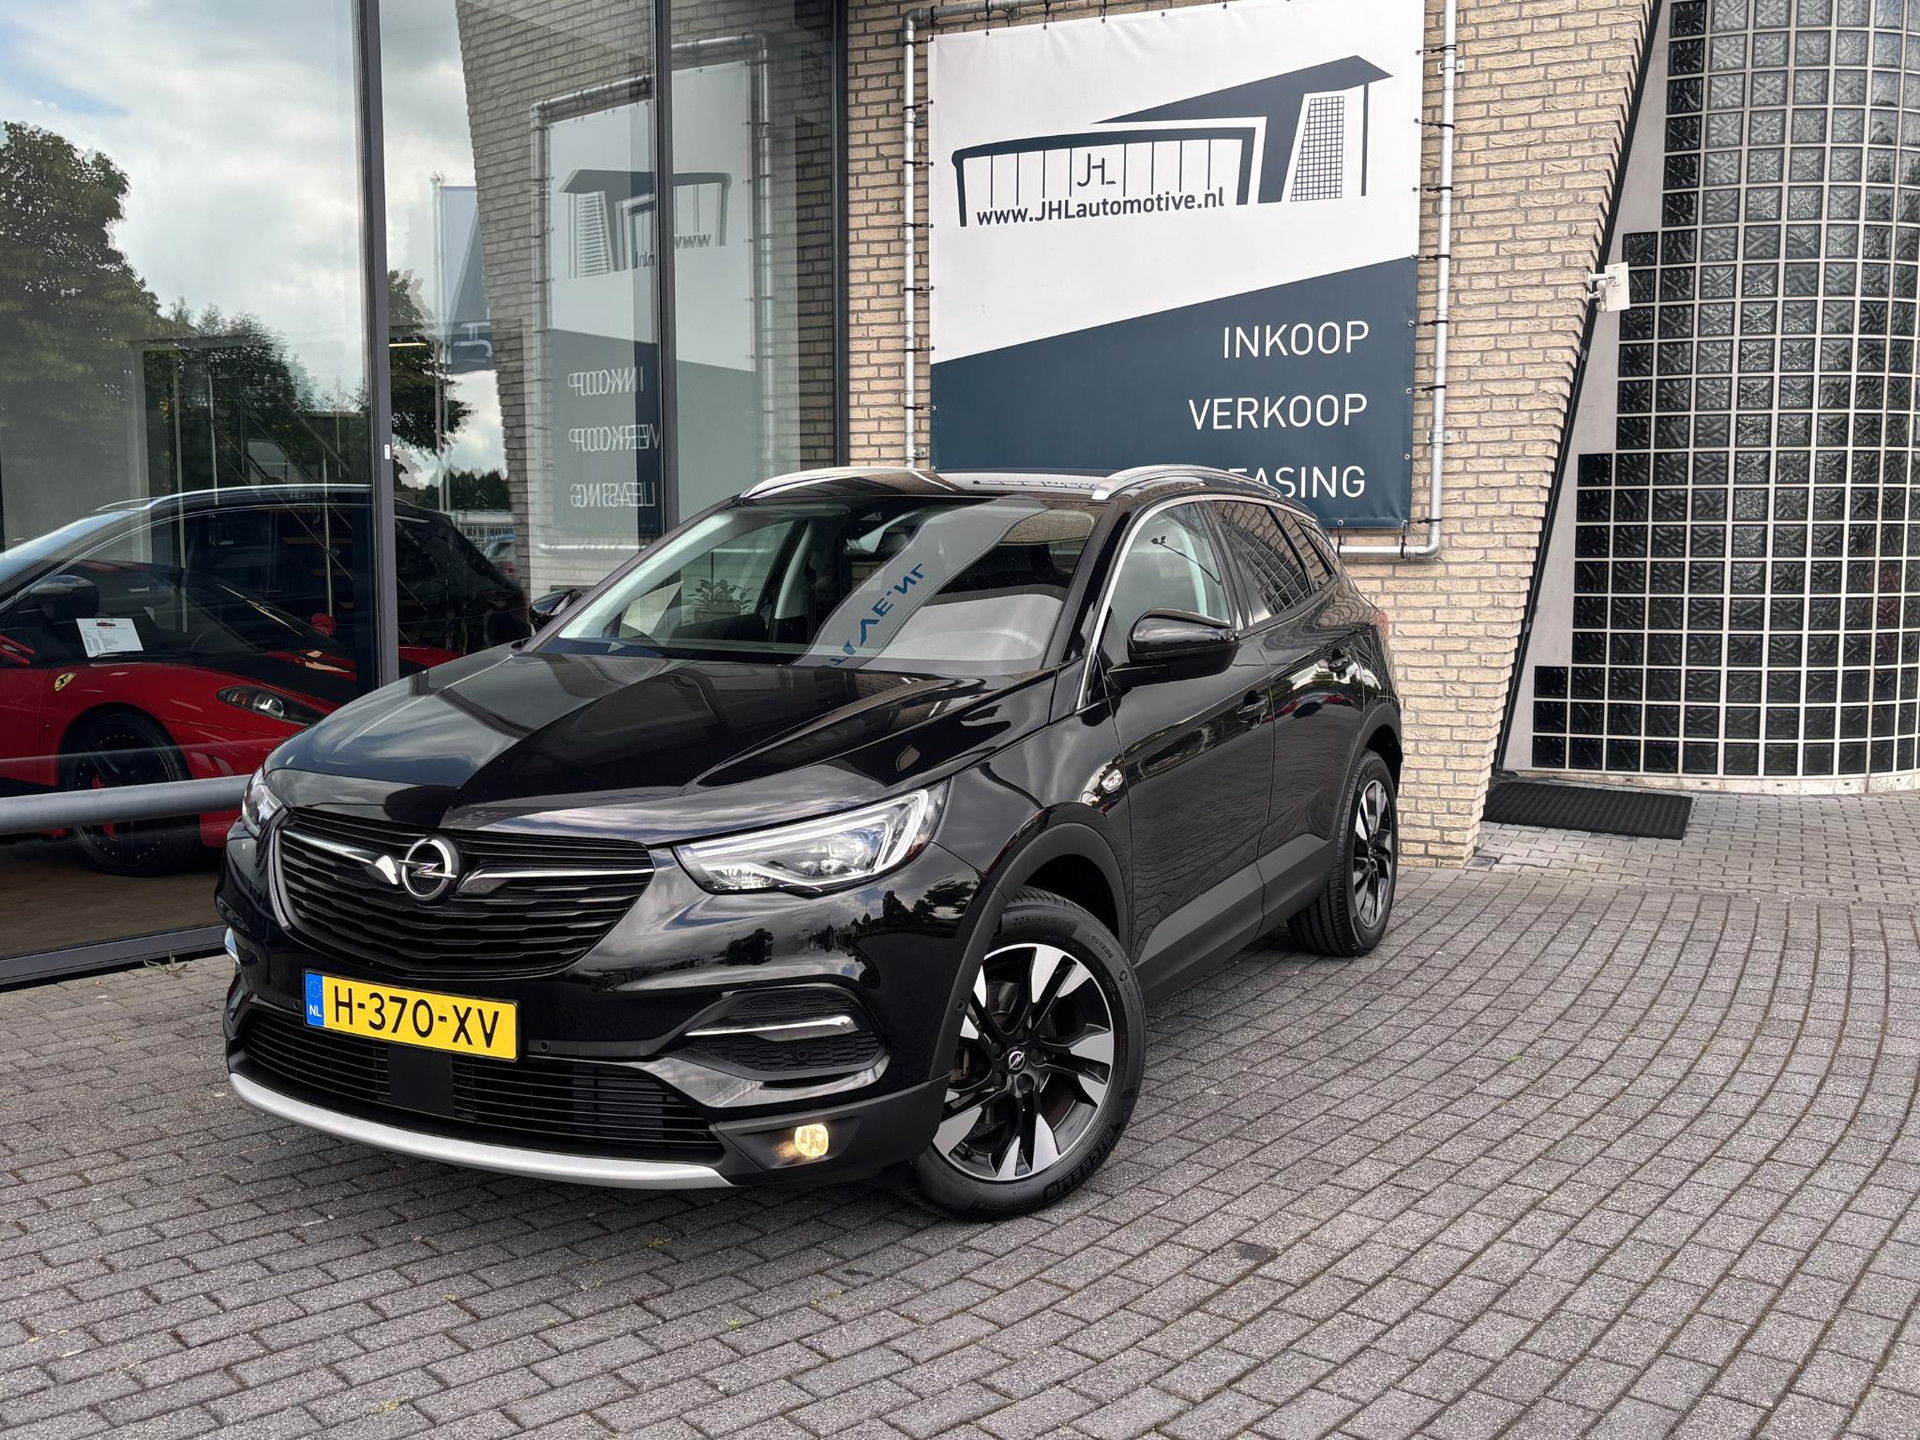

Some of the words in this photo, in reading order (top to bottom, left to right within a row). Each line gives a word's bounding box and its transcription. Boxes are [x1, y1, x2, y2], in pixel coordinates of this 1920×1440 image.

[977, 187, 1224, 226] www.JHLautomotive.nl
[1223, 320, 1369, 359] INKOOP
[1188, 393, 1368, 430] VERKOOP
[1228, 465, 1366, 499] ASING
[308, 1004, 323, 1018] NL
[333, 985, 500, 1049] H-370-XV
